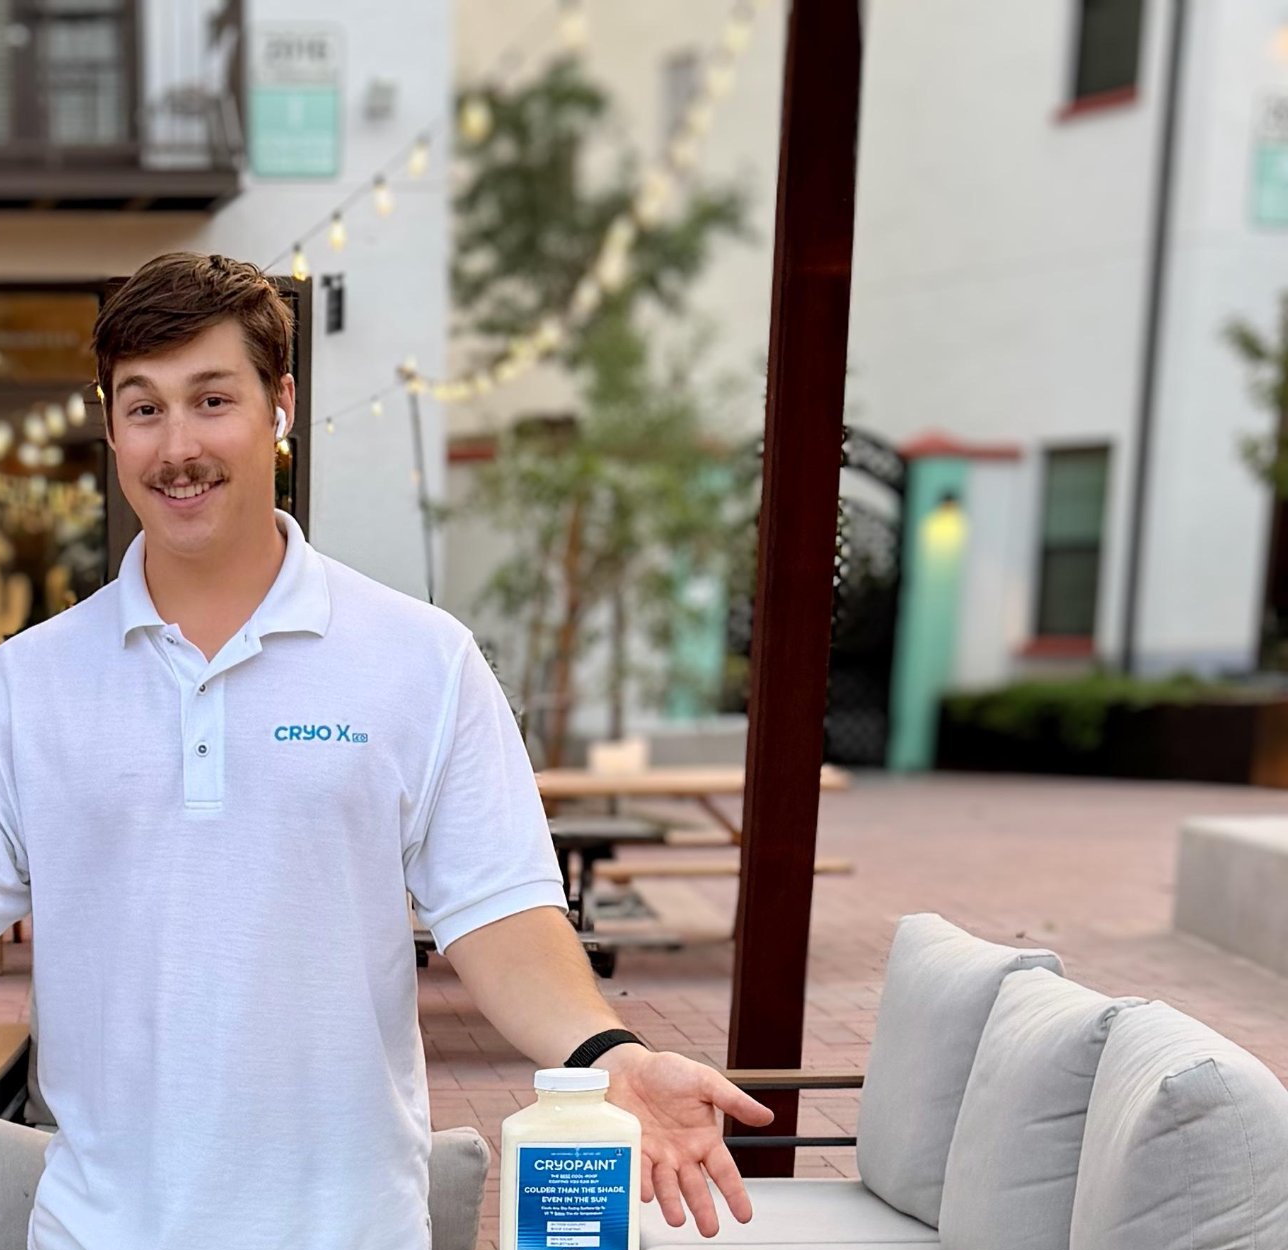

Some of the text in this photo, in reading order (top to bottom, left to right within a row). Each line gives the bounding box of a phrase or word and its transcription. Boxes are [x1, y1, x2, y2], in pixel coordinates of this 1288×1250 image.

[274, 724, 332, 741] CRYO
[336, 724, 350, 742] X
[534, 1160, 617, 1170] CRYOPAINT
